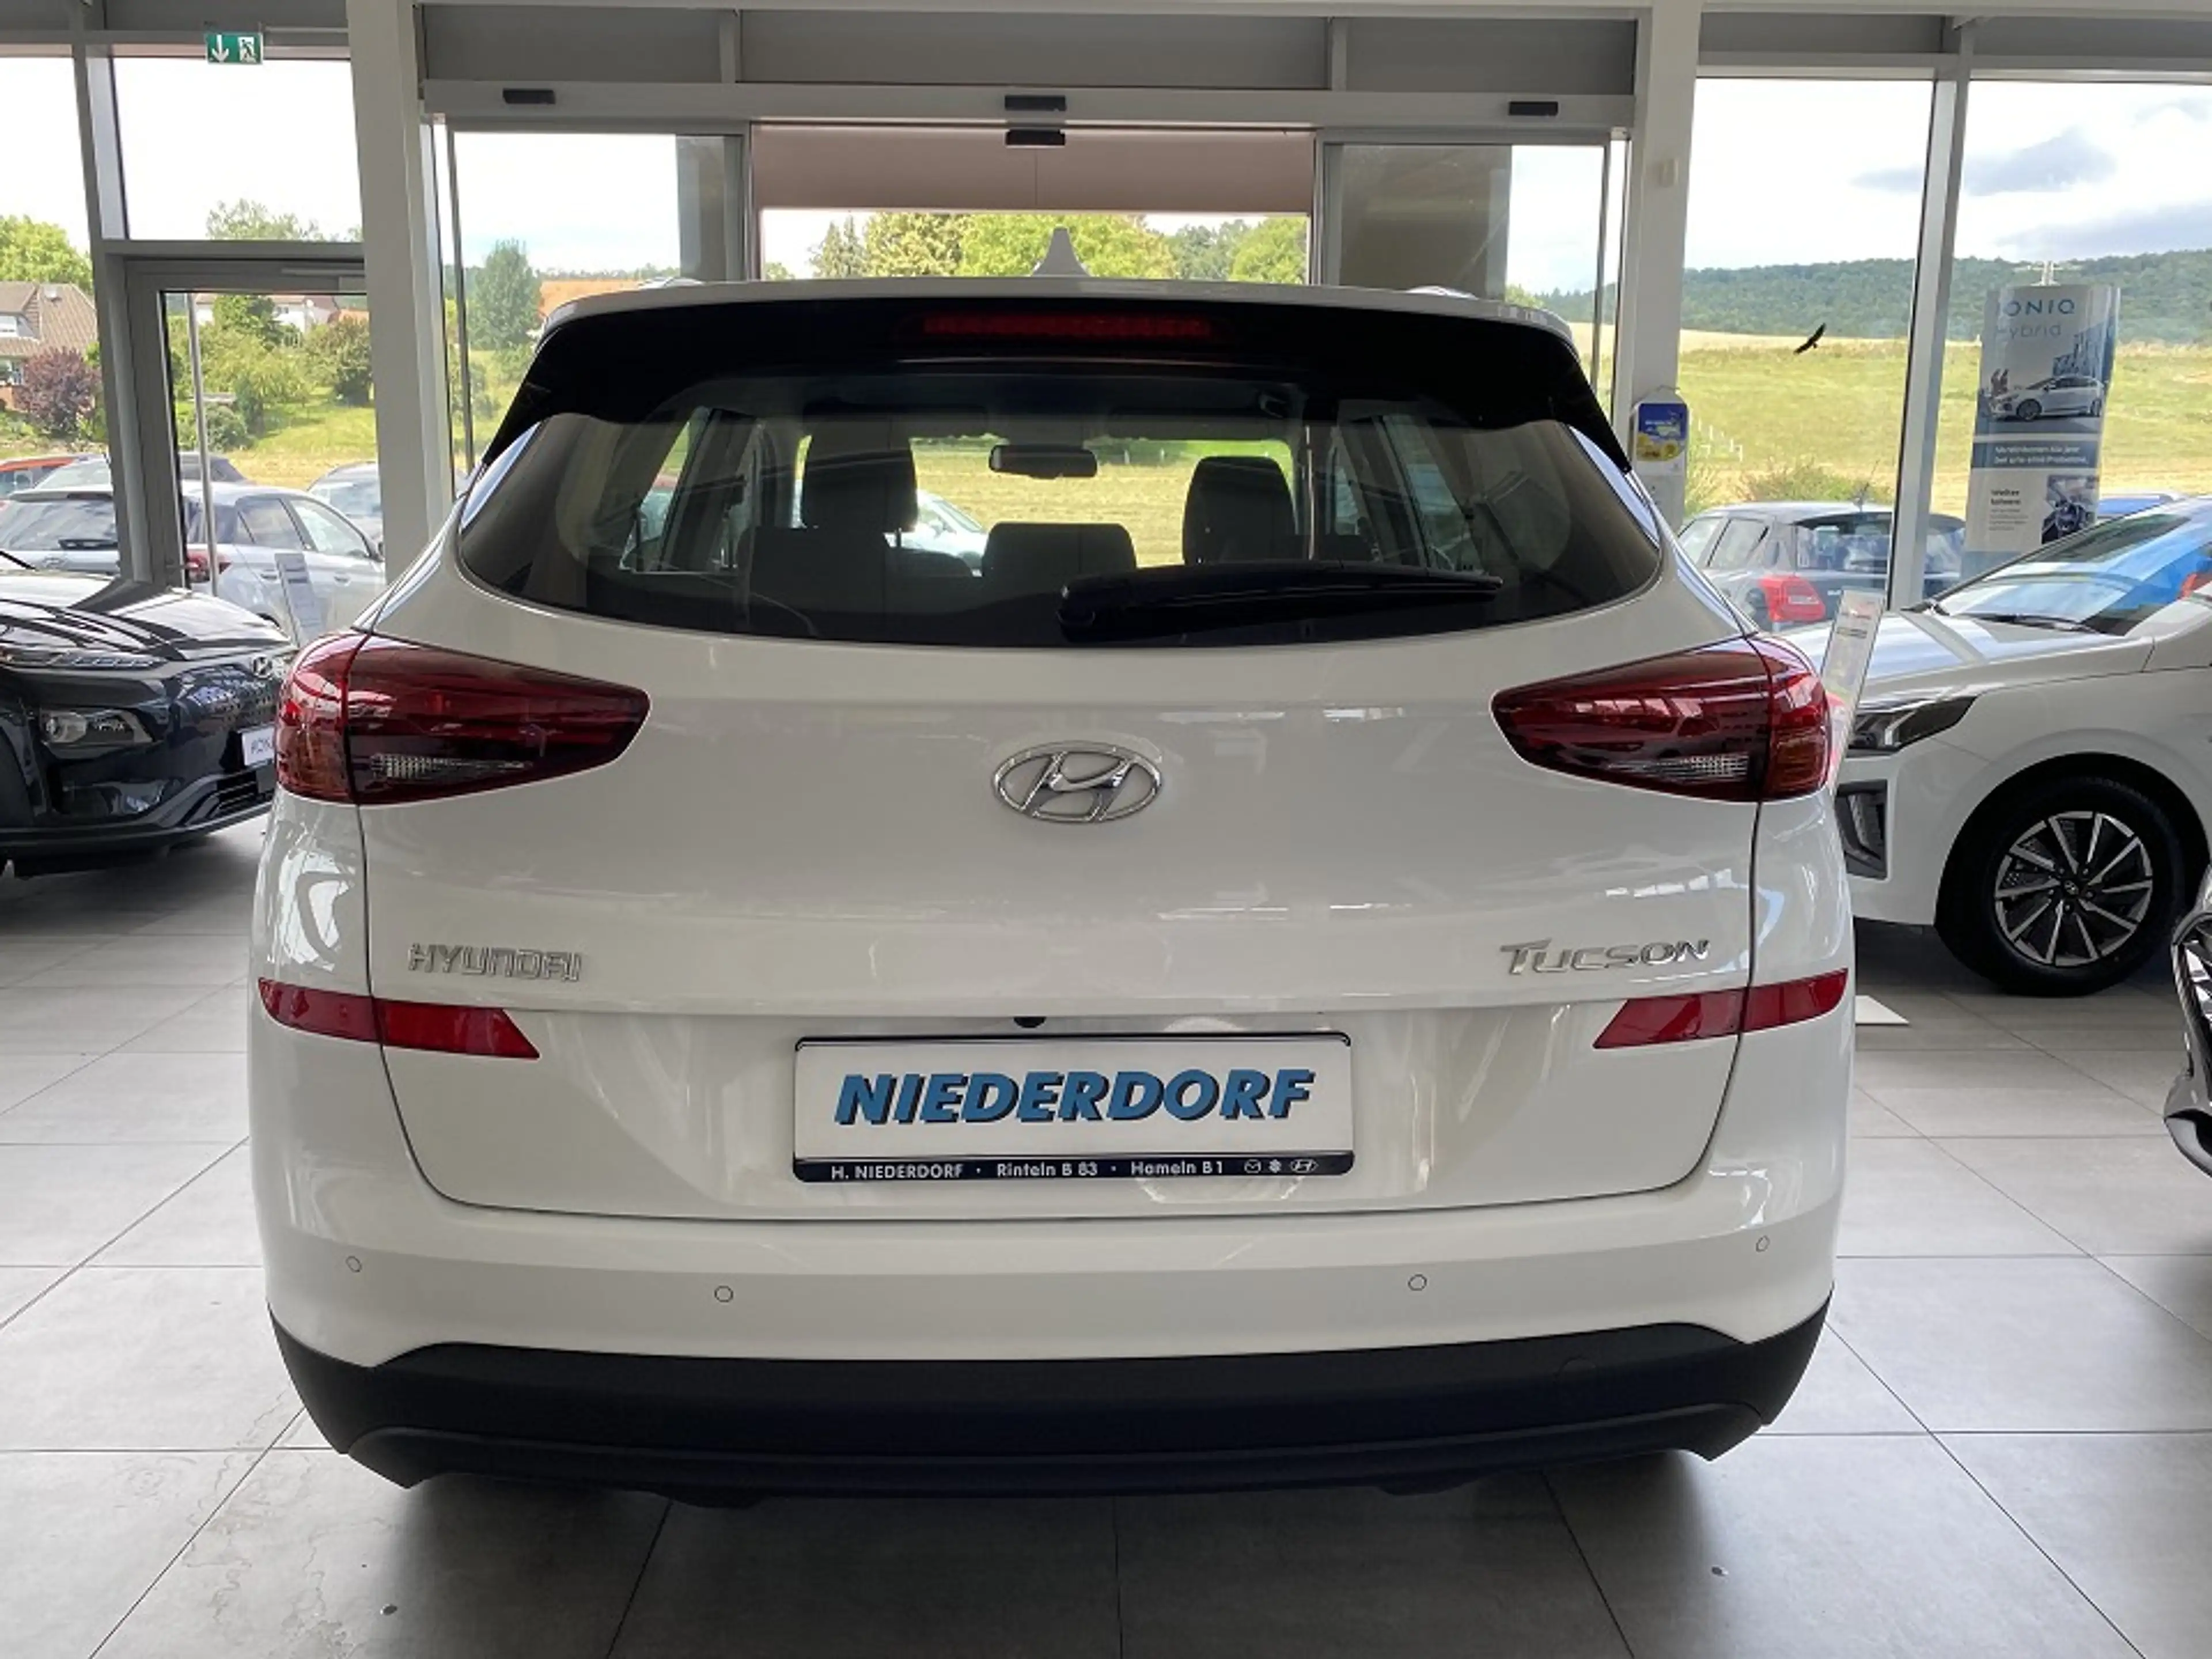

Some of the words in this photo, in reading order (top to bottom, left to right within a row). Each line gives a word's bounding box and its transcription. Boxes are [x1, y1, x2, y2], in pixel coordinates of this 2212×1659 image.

[407, 942, 581, 982] HYUNDAI
[834, 1069, 1316, 1126] NIEDERDORF
[831, 1165, 850, 1180] H.
[854, 1163, 964, 1179] NIEDERDORF
[997, 1162, 1056, 1177] Rinteln
[1062, 1162, 1073, 1176] B
[1078, 1161, 1099, 1176] 83
[1130, 1160, 1197, 1175] Hameln
[1202, 1160, 1213, 1174] B
[1215, 1161, 1223, 1174] 1
